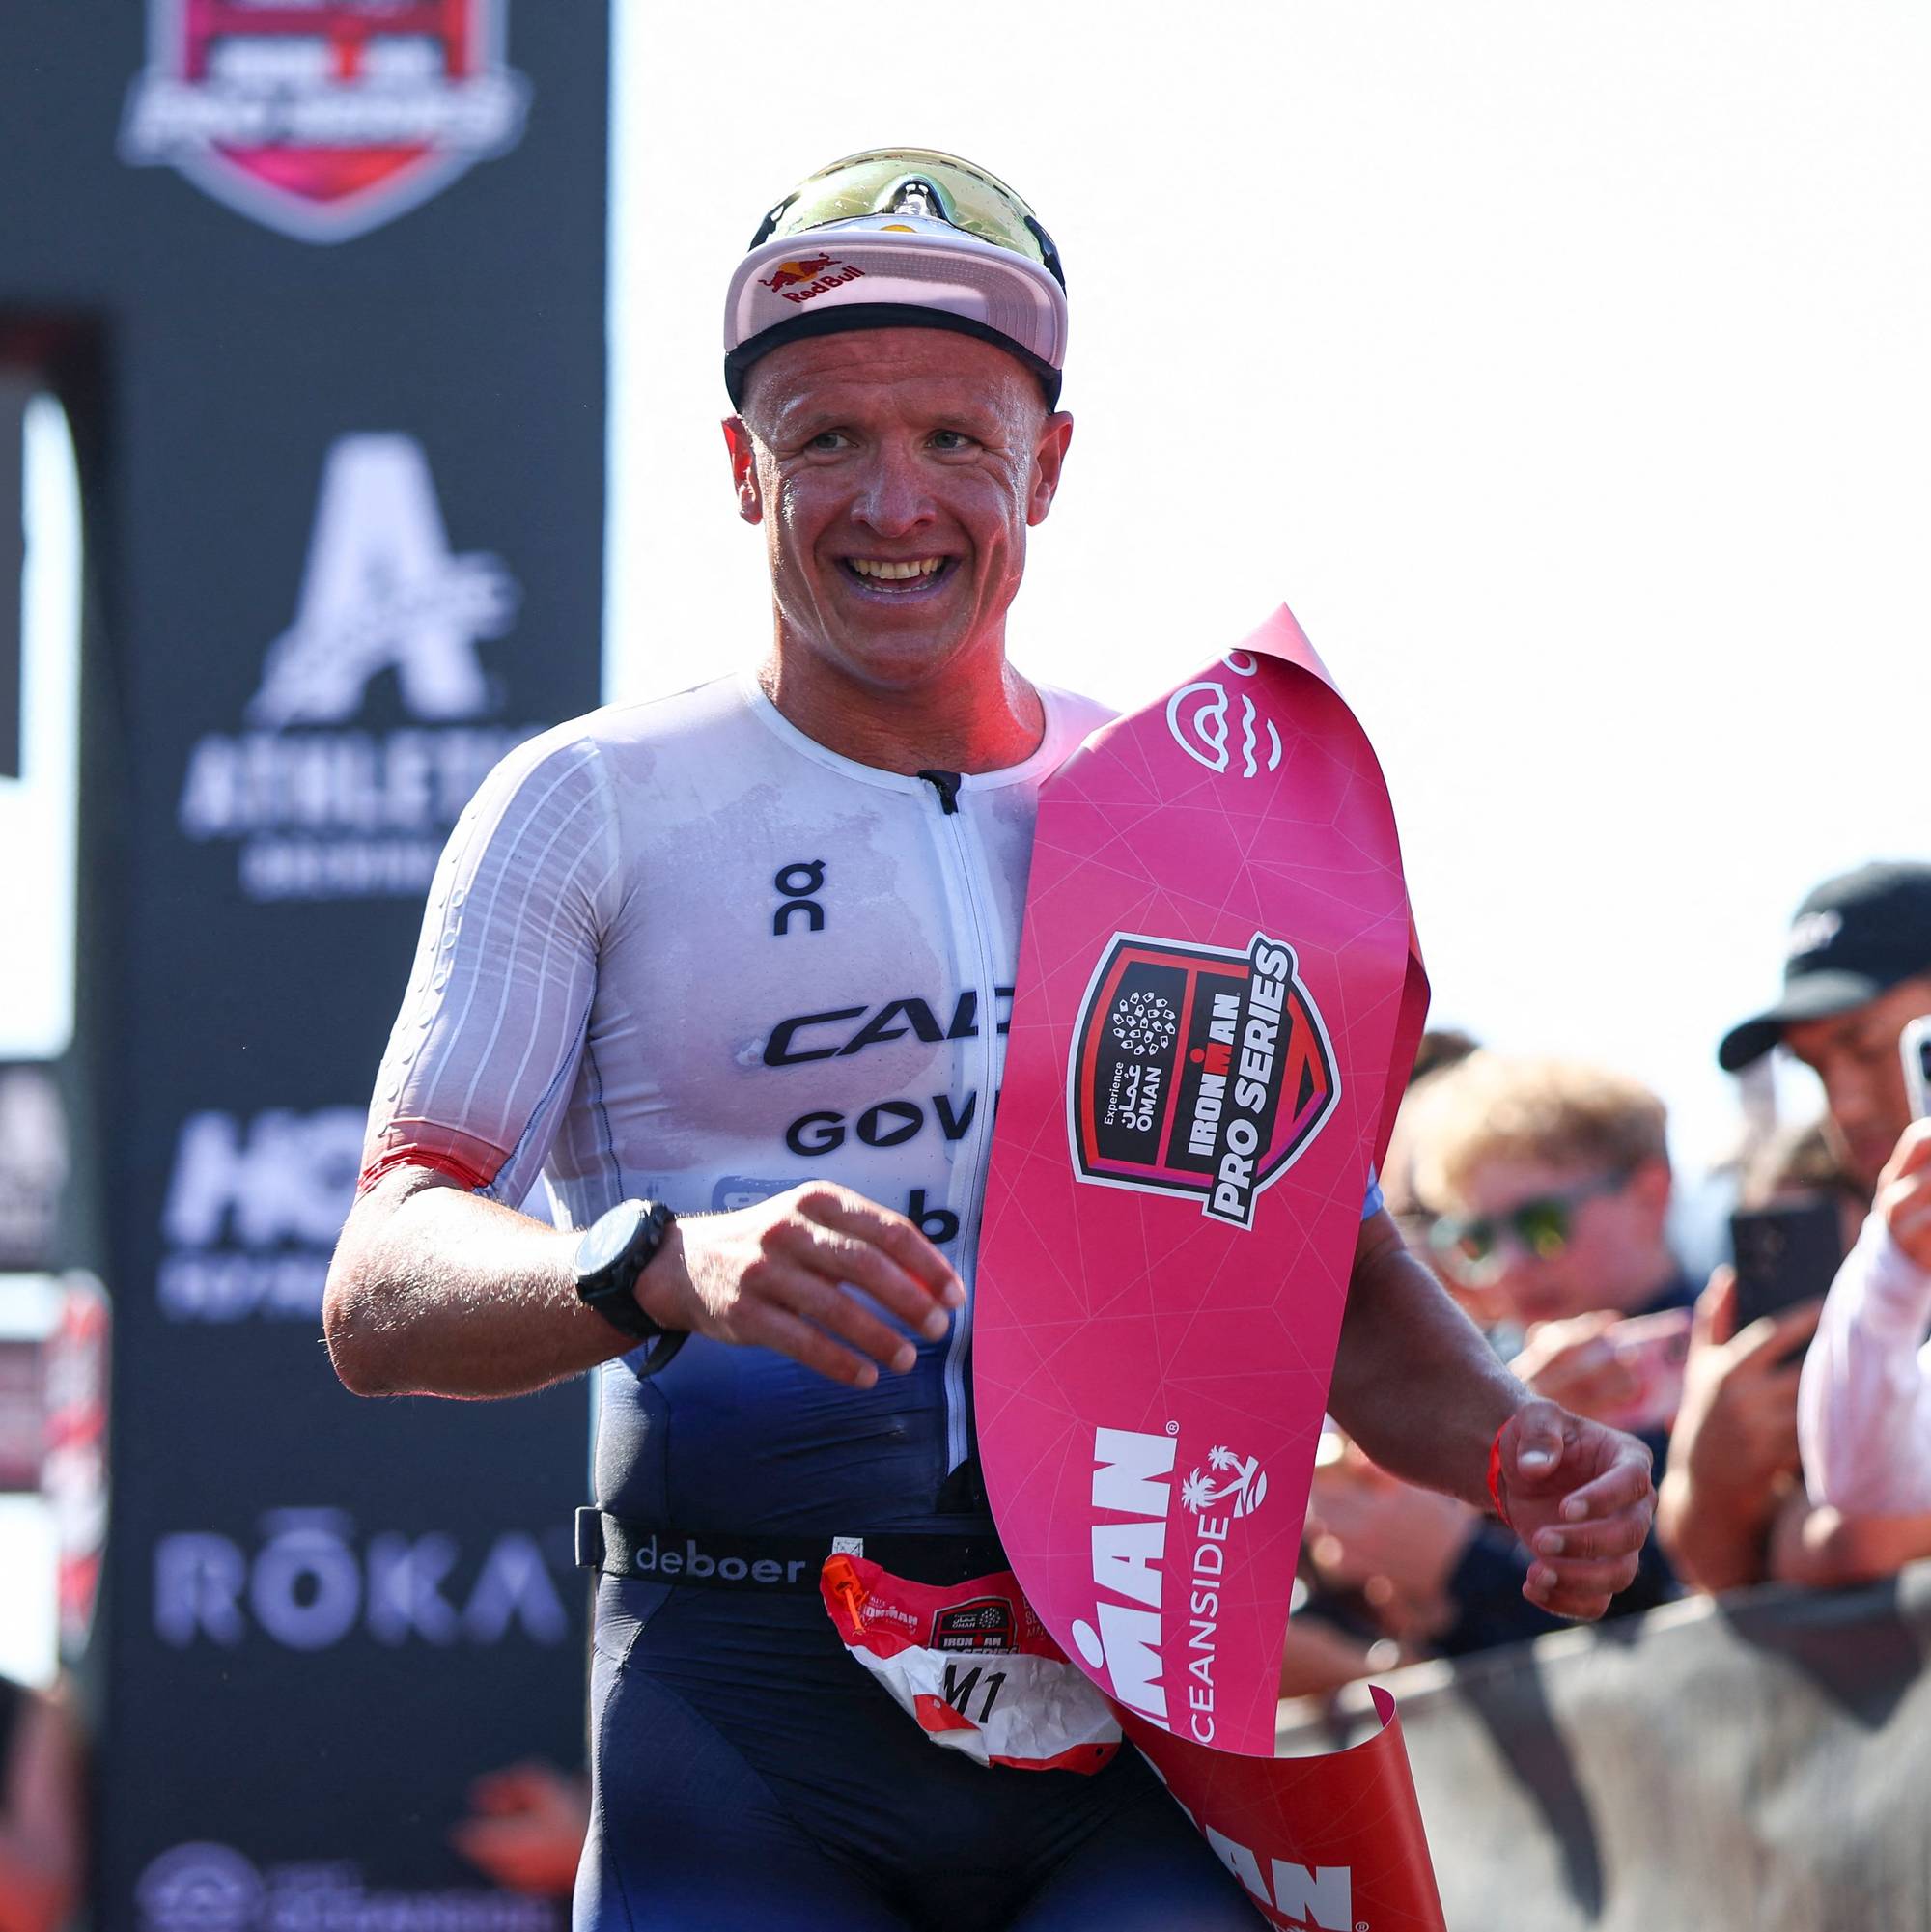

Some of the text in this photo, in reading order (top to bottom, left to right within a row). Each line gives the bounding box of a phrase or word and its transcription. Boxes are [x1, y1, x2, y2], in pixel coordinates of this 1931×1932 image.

[1105, 1062, 1124, 1125] Experience
[1136, 1067, 1162, 1132] OMAN
[1188, 994, 1241, 1157] IRONMAN
[1213, 944, 1289, 1218] PRO SERIES
[636, 1534, 806, 1583] deboer
[1072, 1426, 1178, 1732] MAN
[1189, 1513, 1230, 1743] CEANSIDE
